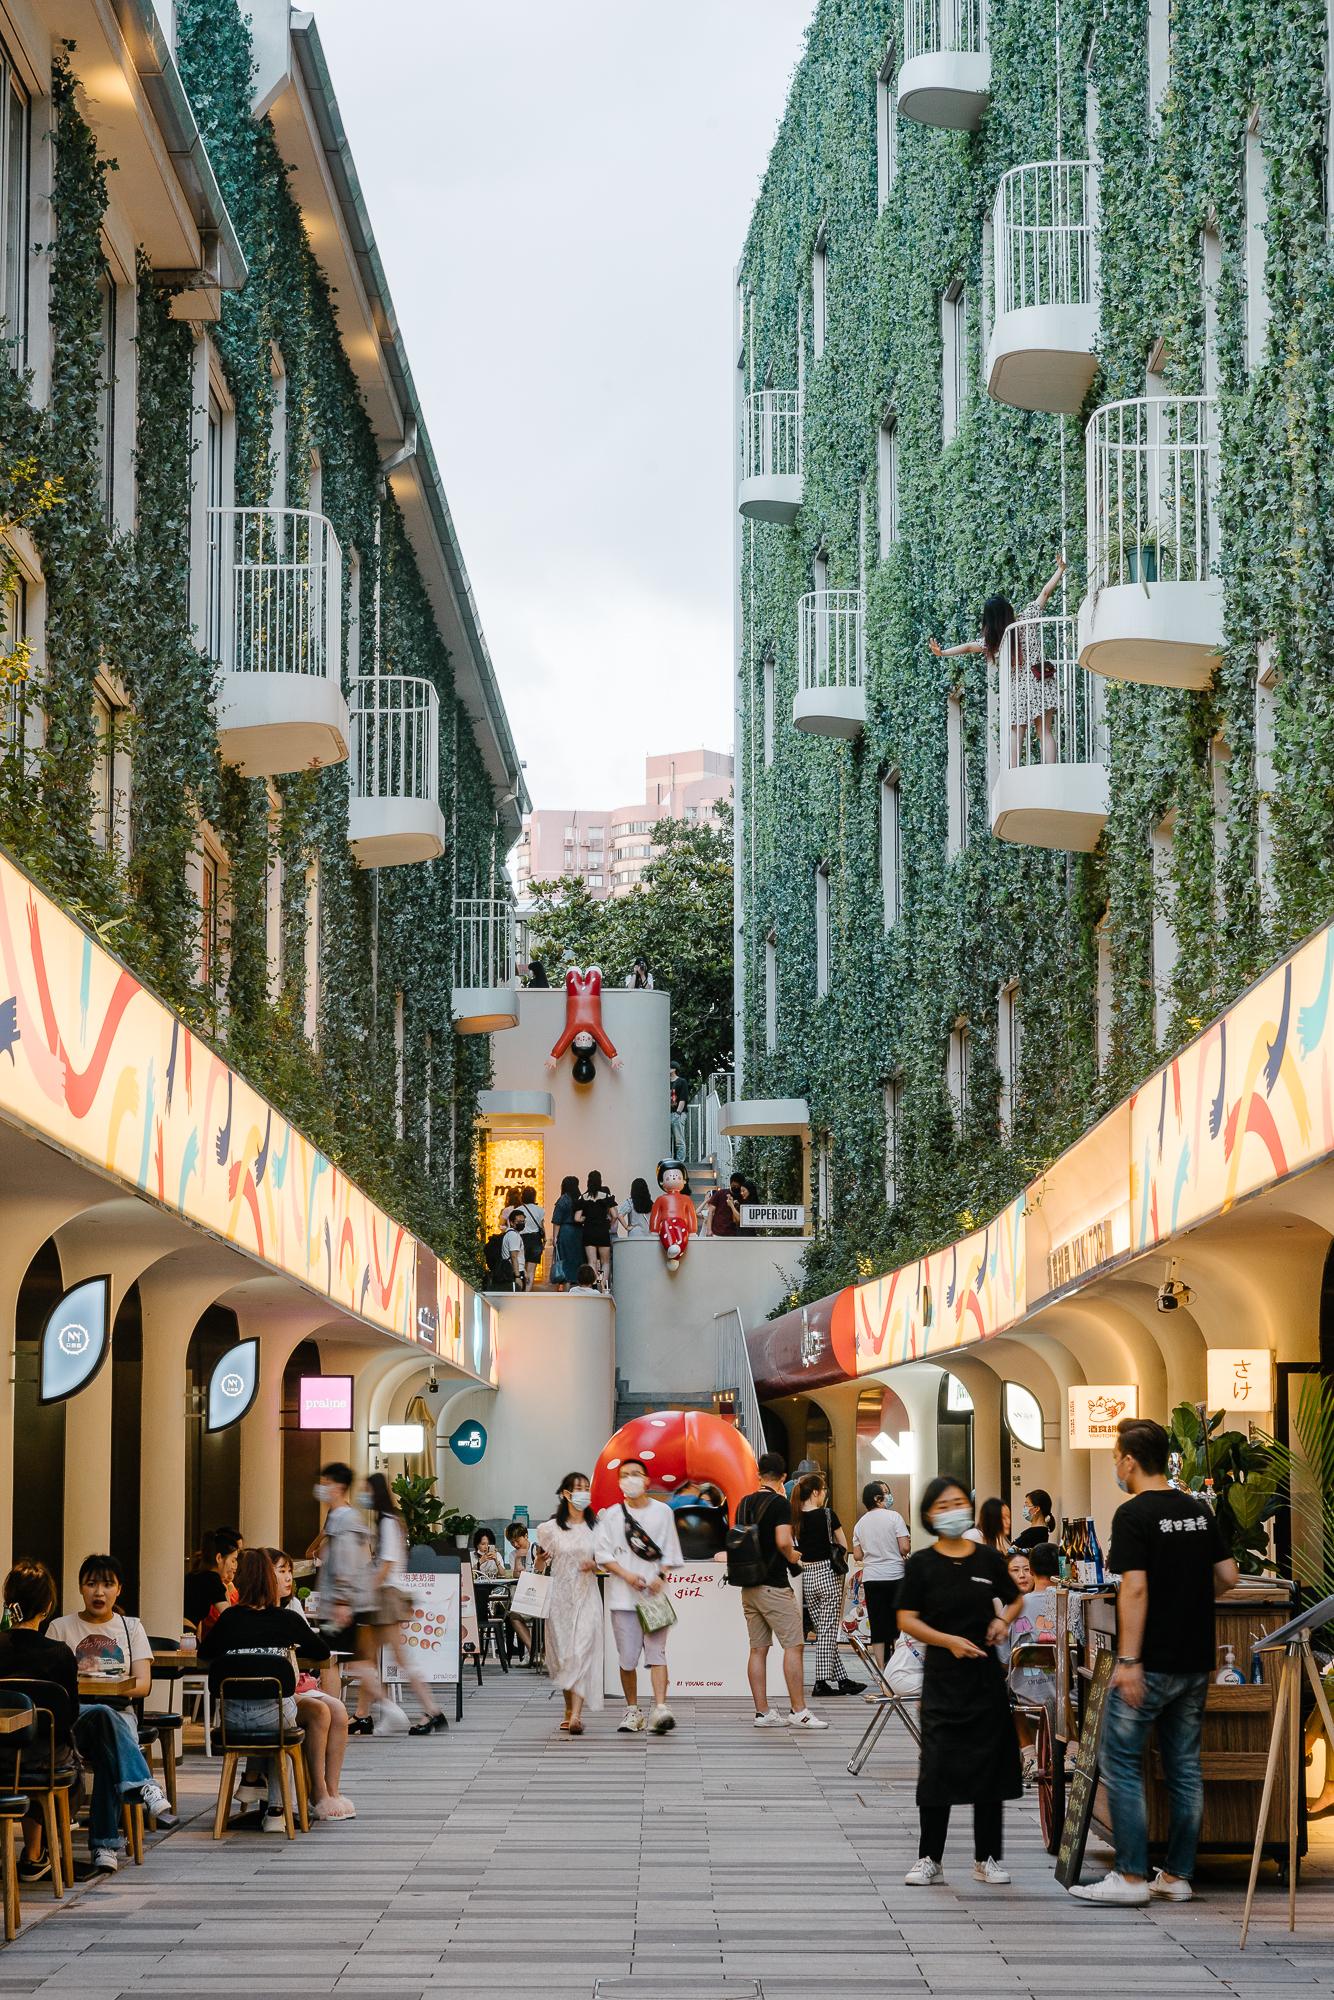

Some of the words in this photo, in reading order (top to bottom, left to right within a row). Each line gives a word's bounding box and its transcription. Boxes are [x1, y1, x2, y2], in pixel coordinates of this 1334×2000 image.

[504, 1167, 537, 1179] ma
[749, 1208, 778, 1220] UPPER
[781, 1208, 799, 1220] CUT
[1233, 1360, 1252, 1401] さけ
[1088, 1425, 1120, 1434] 酒食胡
